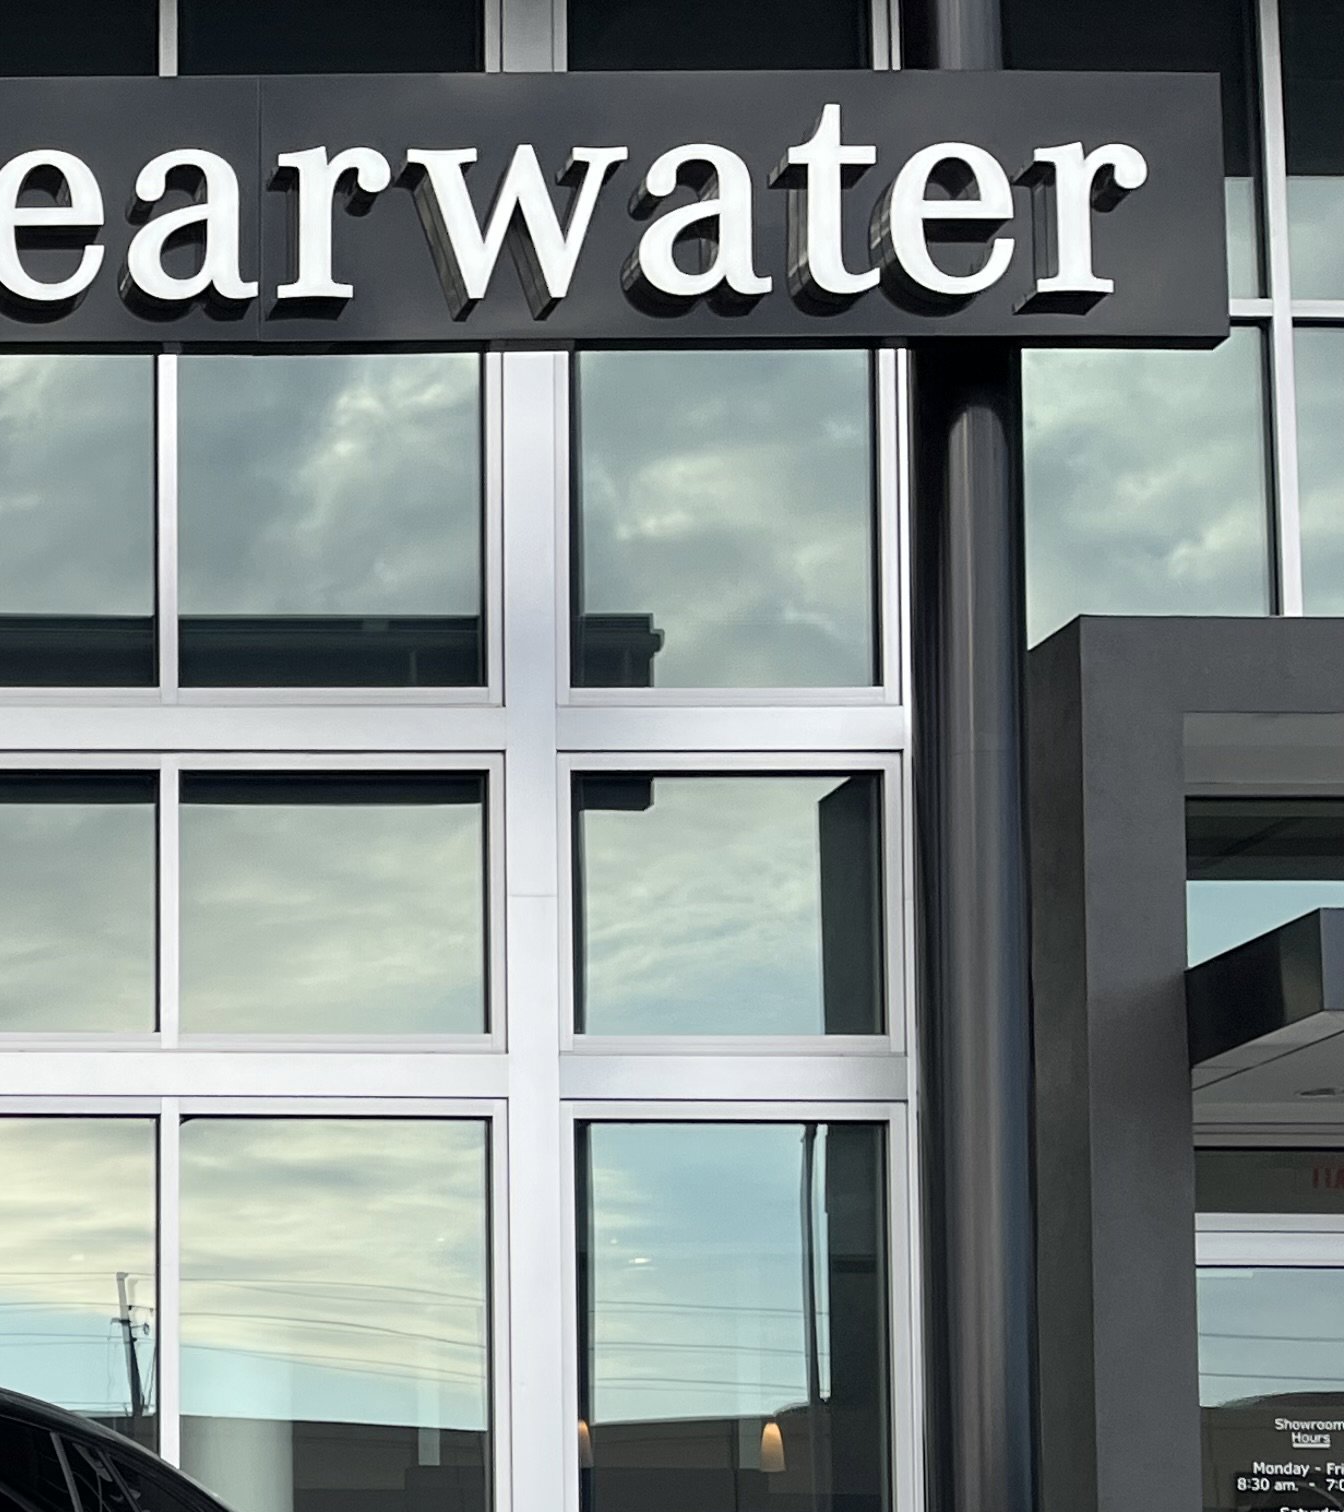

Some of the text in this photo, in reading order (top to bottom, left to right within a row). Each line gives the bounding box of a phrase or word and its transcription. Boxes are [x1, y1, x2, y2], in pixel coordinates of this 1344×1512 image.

[1274, 1417, 1344, 1431] Showroom
[1291, 1431, 1331, 1444] Hours
[1252, 1461, 1310, 1477] Monday
[1236, 1477, 1271, 1491] 8:30
